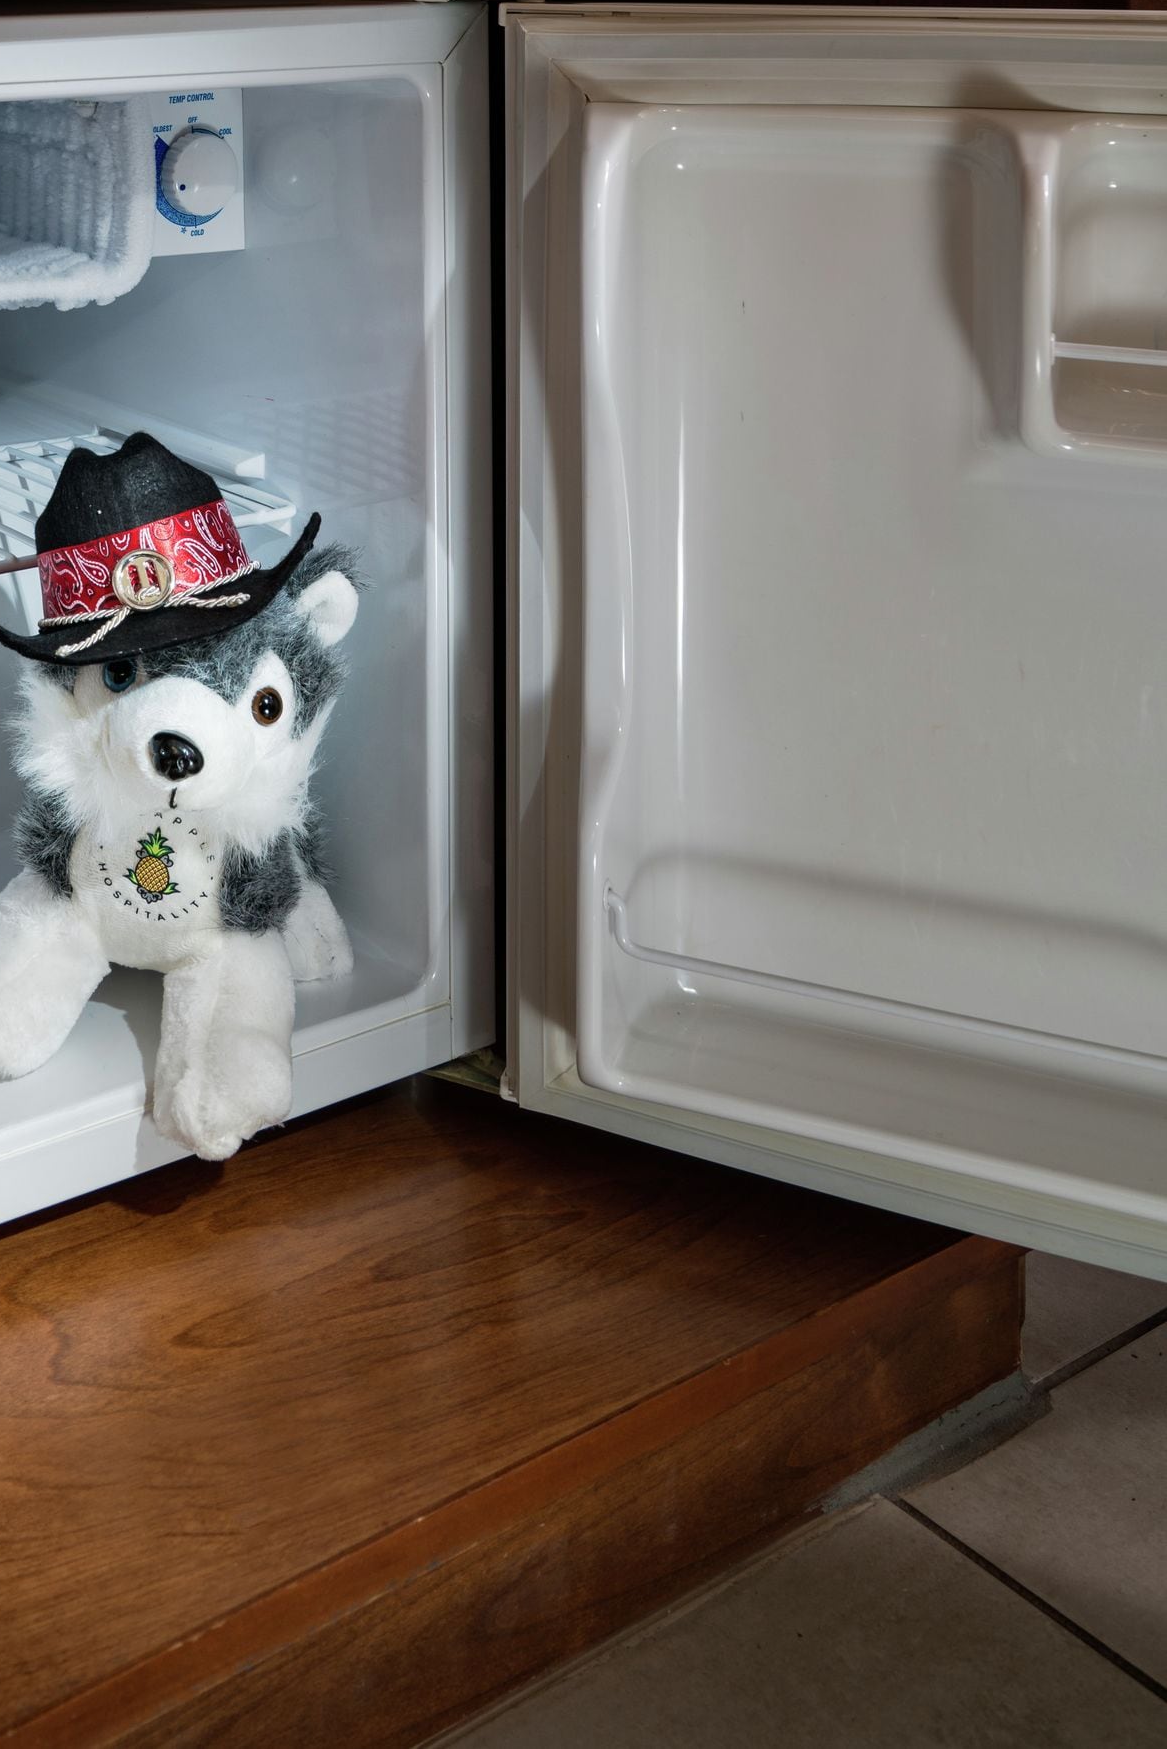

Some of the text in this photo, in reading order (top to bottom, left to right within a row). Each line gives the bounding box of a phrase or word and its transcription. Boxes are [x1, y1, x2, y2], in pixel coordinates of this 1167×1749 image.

[168, 93, 214, 104] TEMP CONTROL
[187, 116, 198, 124] OFF
[153, 124, 173, 133] OLDEST
[218, 128, 232, 136] COOL
[190, 229, 204, 237] COLD
[98, 862, 208, 921] HOSPITALITY
